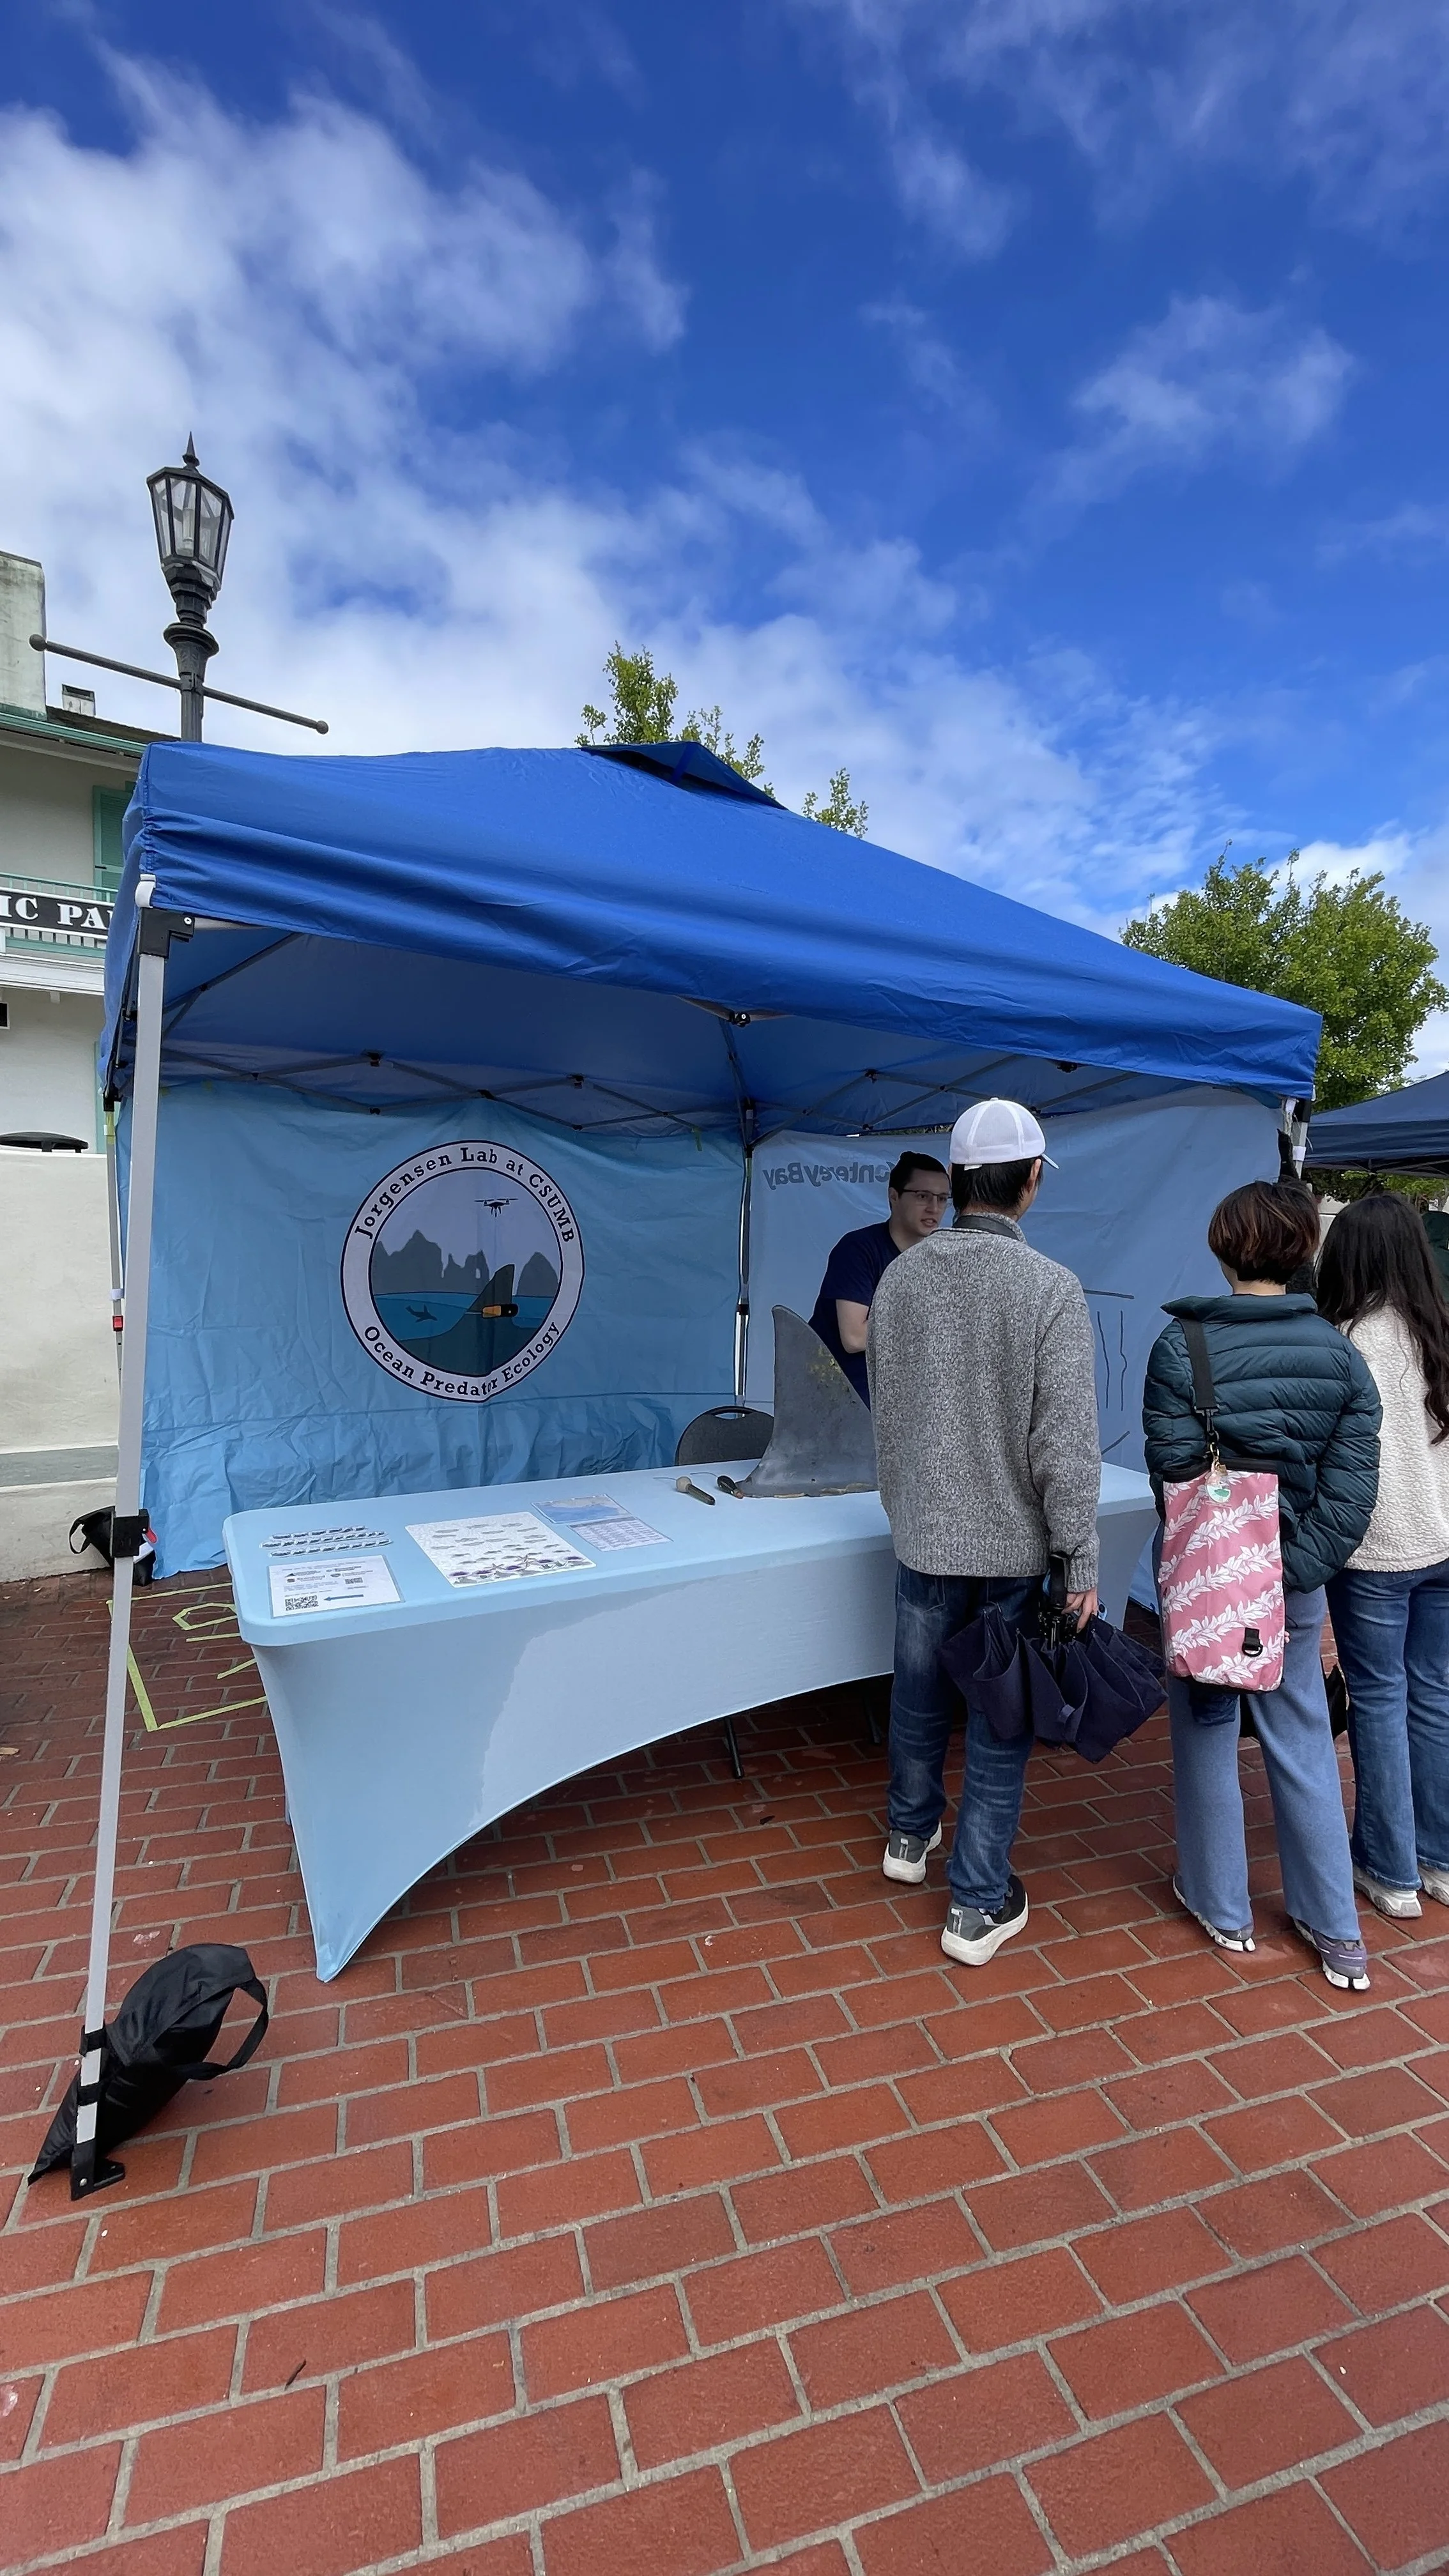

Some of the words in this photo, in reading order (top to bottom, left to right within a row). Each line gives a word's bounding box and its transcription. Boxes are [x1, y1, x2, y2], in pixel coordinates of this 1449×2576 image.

[57, 903, 113, 930] PA
[355, 1154, 452, 1239] Jorgensen
[460, 1147, 497, 1163] Lab
[506, 1160, 523, 1176] at
[529, 1174, 574, 1242] CSUMB
[365, 1326, 415, 1379] Ocean
[420, 1372, 498, 1396] Predator
[502, 1322, 560, 1382] Ecology
